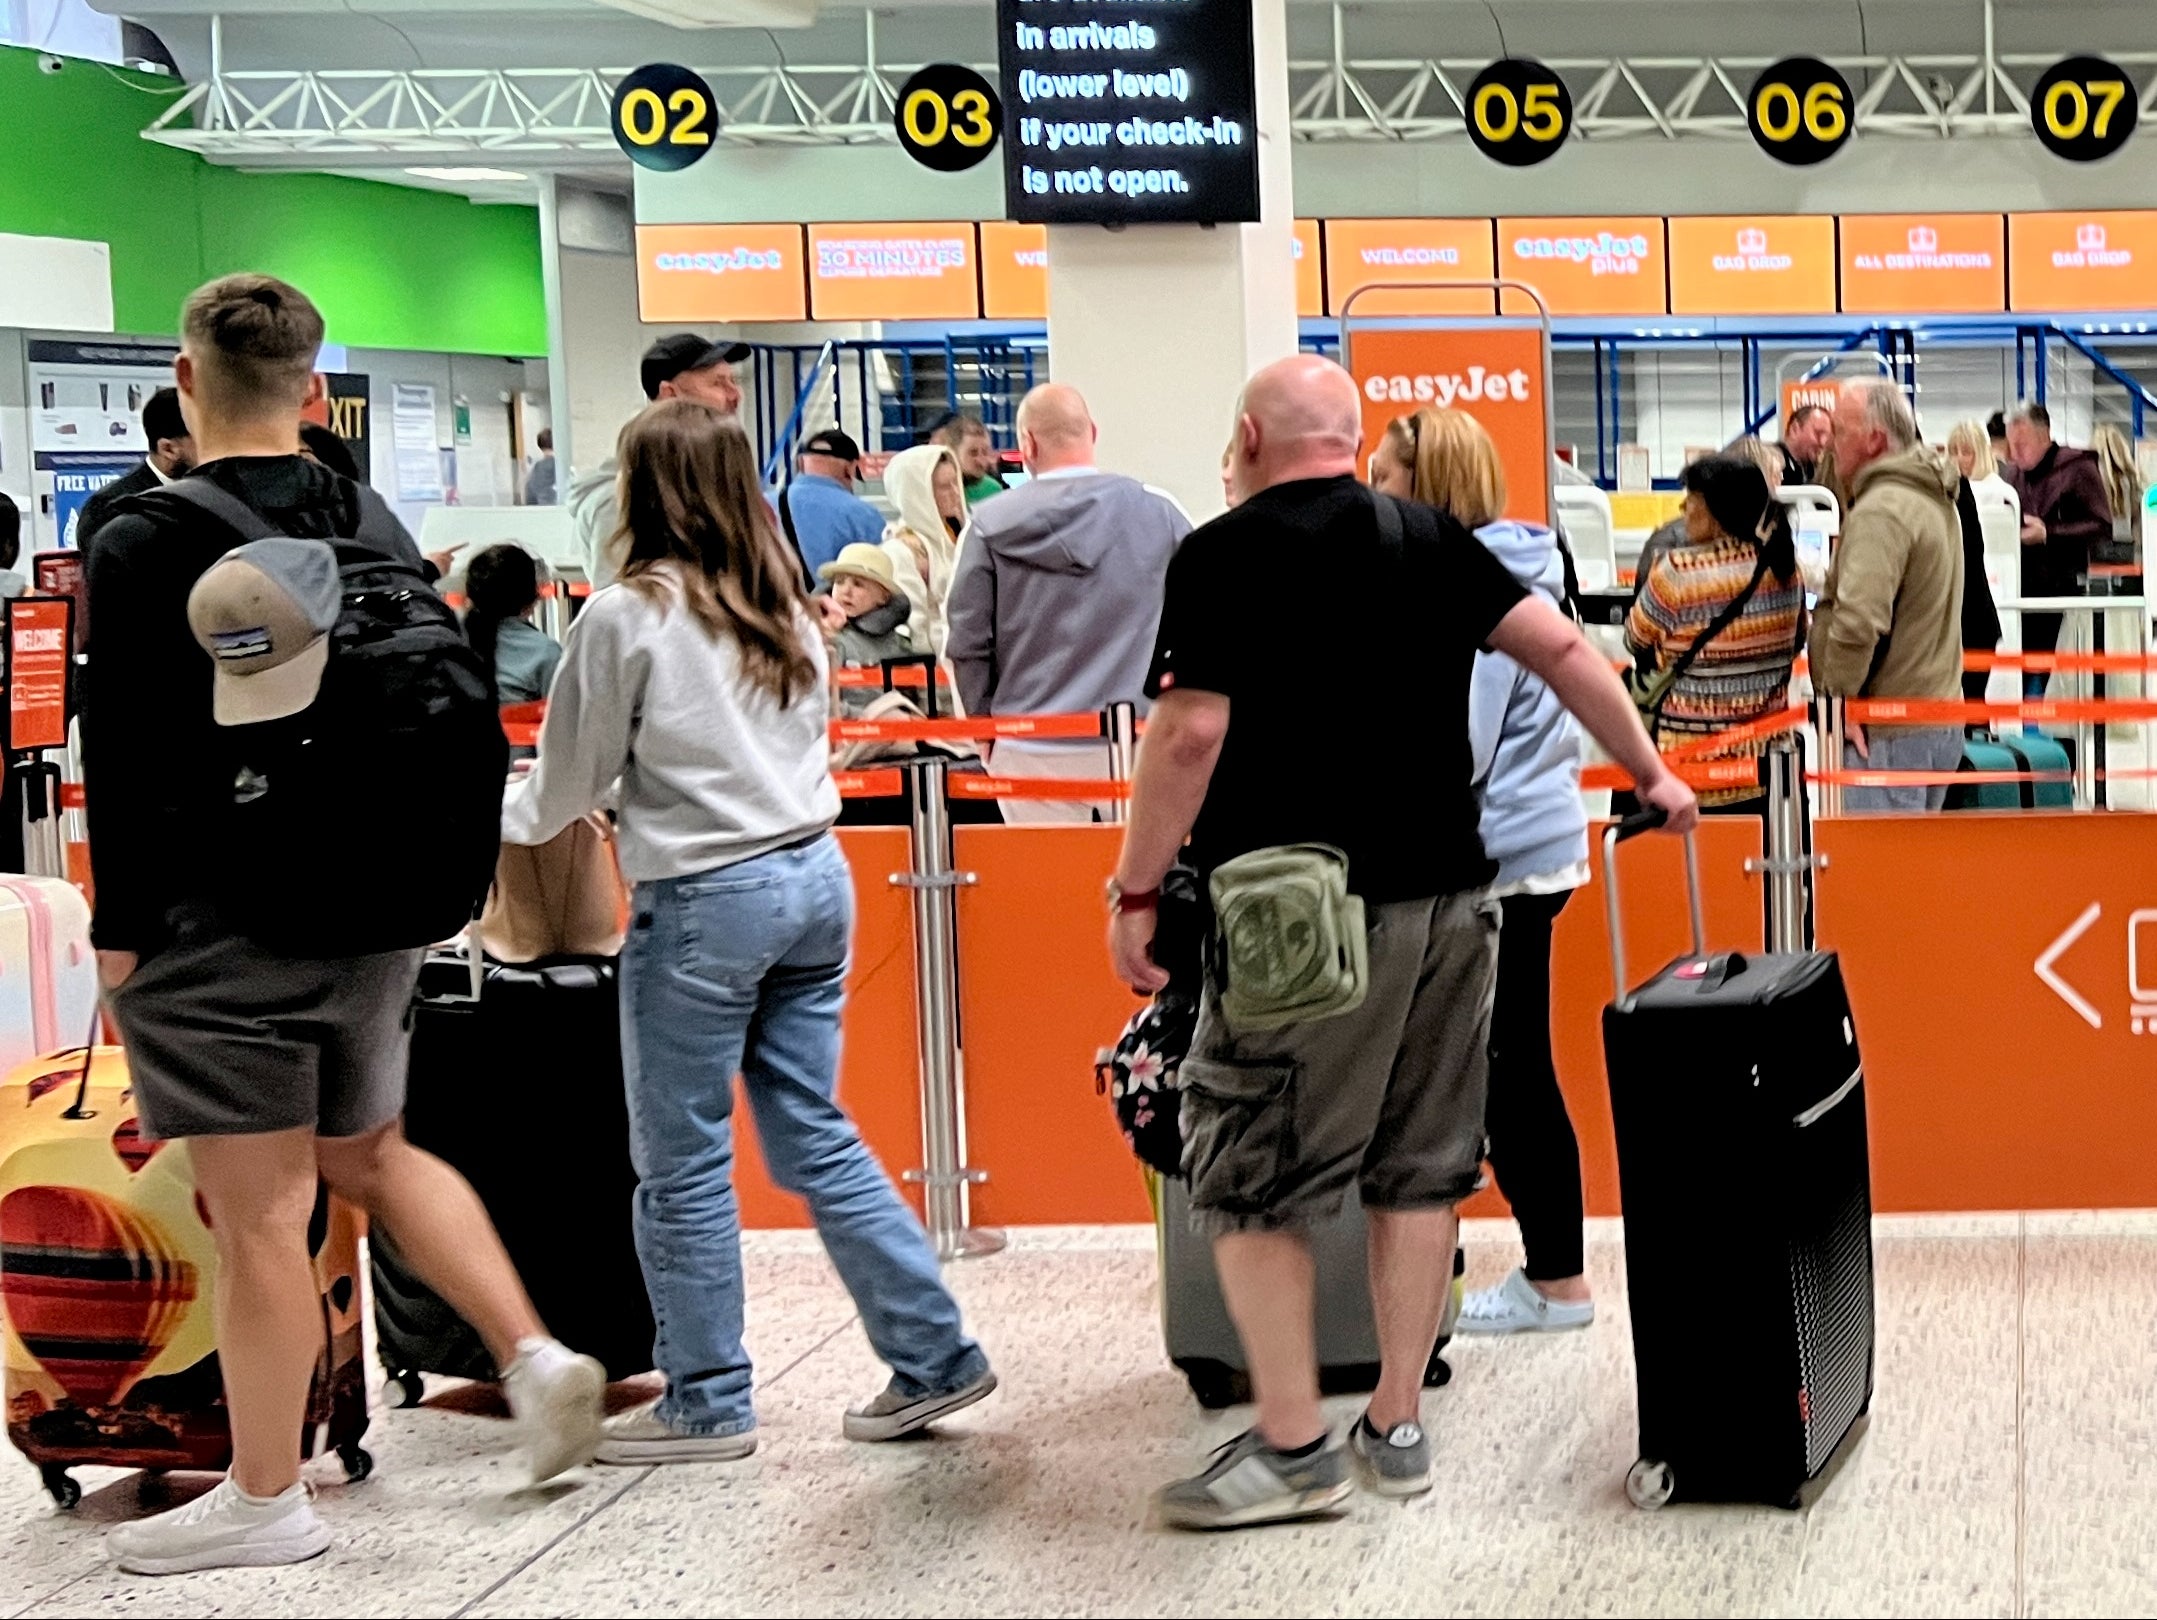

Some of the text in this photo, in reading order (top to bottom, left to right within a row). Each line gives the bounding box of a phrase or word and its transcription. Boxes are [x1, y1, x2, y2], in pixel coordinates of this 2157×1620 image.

[1016, 20, 1157, 50] in arrivals
[1018, 68, 1189, 102] (lower level)
[619, 87, 709, 146] 02
[903, 87, 993, 147] 03
[1473, 83, 1564, 142] 05
[1756, 82, 1846, 142] 06
[2043, 80, 2126, 139] 07
[1020, 116, 1241, 151] if your check-in
[1022, 165, 1190, 198] is not open.
[820, 249, 965, 268] 30 MINUTES
[1361, 248, 1458, 264] WELCOME
[1514, 232, 1647, 260] easyJet
[1854, 255, 1884, 270] ALL
[1591, 257, 1639, 276] plus
[1364, 366, 1530, 408] easyJet
[329, 396, 367, 439] XIT
